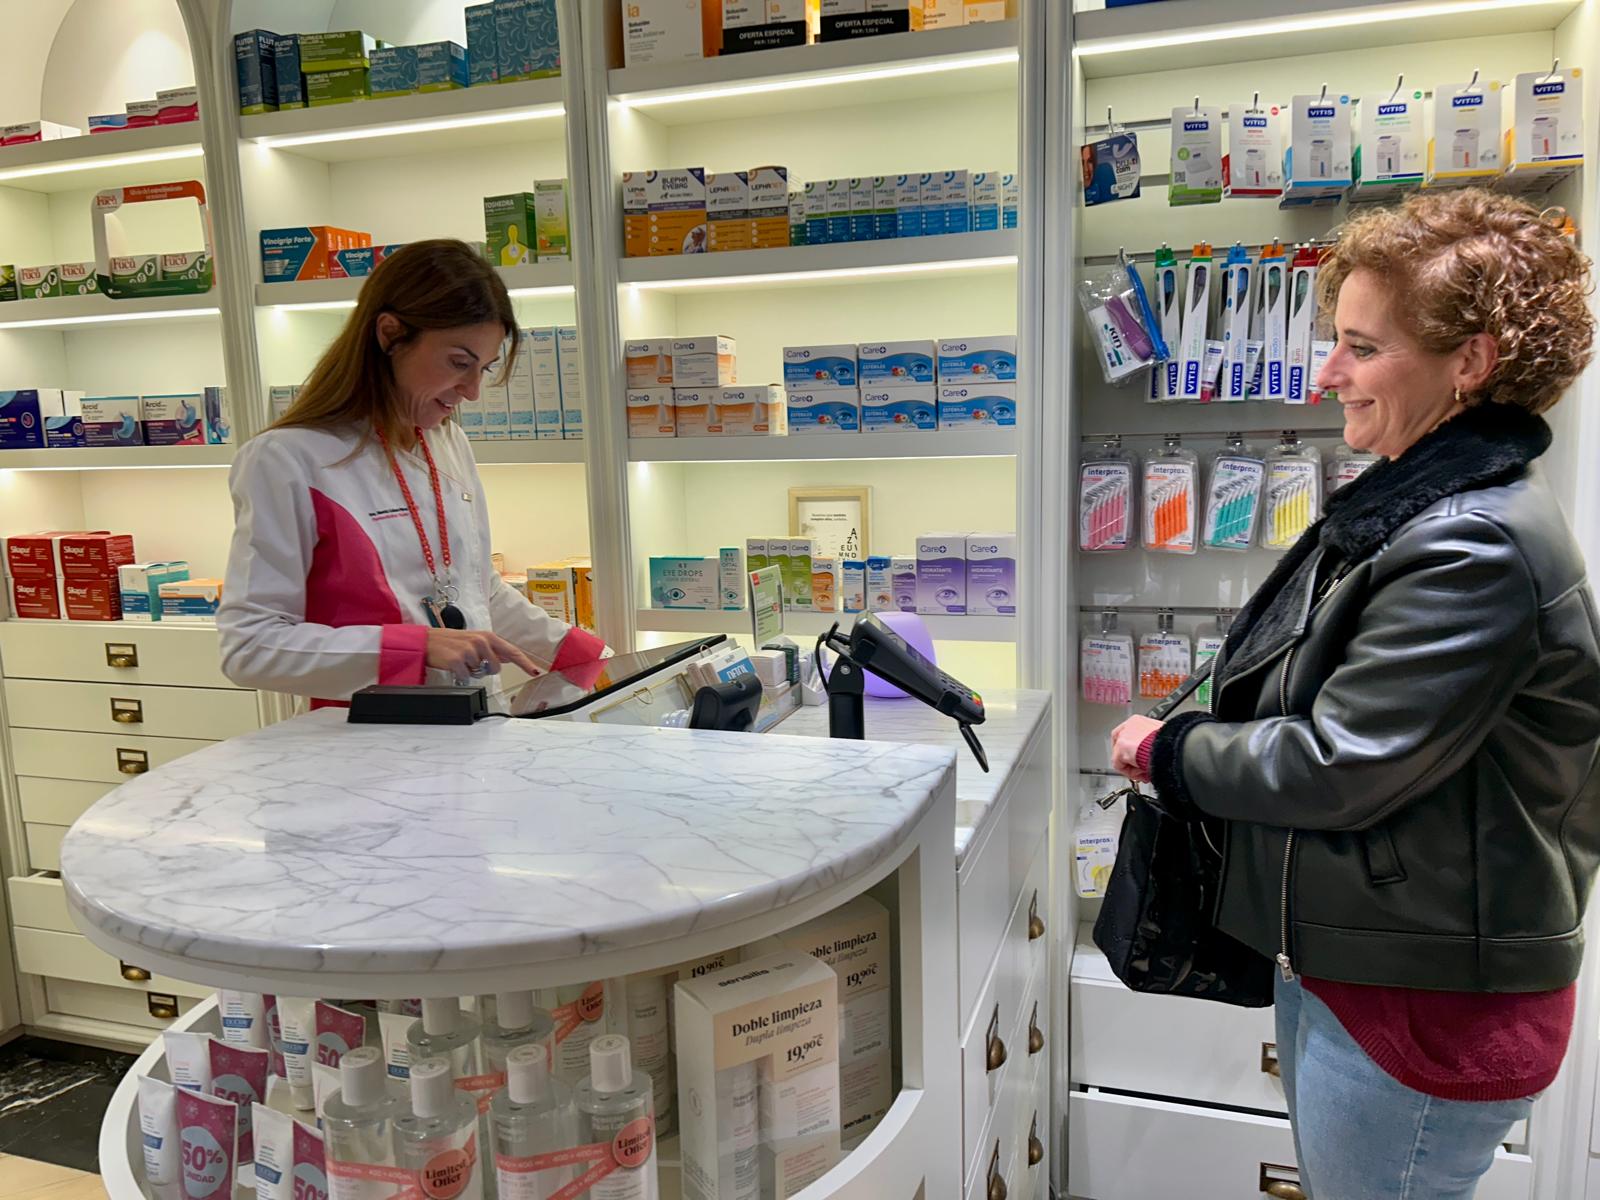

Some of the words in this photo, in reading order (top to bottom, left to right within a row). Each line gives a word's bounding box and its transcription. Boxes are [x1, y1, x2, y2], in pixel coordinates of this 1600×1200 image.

[834, 19, 861, 29] OFERTA
[862, 17, 895, 27] ESPECIAL
[738, 30, 764, 40] OFERTA
[764, 28, 796, 38] ESPECIAL
[1534, 83, 1563, 93] VITIS
[1453, 96, 1482, 106] VITIS
[1308, 108, 1334, 117] VITIS
[1379, 104, 1406, 114] VITIS
[1185, 121, 1209, 130] VITIS
[1244, 118, 1266, 127] VITIS
[662, 183, 688, 191] EYEBAG
[293, 235, 313, 244] Forte
[1170, 363, 1178, 394] VITIS
[1187, 362, 1197, 392] VITIS
[1232, 364, 1241, 394] VITIS
[1271, 363, 1280, 393] VITIS
[1291, 367, 1300, 398] VITIS
[851, 528, 857, 536] A
[663, 569, 677, 577] EYE
[678, 569, 703, 577] DROPS
[1089, 641, 1121, 651] interprox
[1147, 637, 1181, 645] interprox
[808, 945, 832, 960] oble
[834, 931, 878, 953] limpieza
[718, 968, 770, 988] sensilis
[732, 1015, 770, 1037] Doble
[771, 998, 823, 1025] limpieza
[744, 1028, 775, 1047] Dupla
[776, 1017, 812, 1037] limpeza
[317, 1049, 344, 1069] 50
[618, 1126, 651, 1150] Limited
[182, 1142, 224, 1171] 50%
[425, 1158, 468, 1180] Limited
